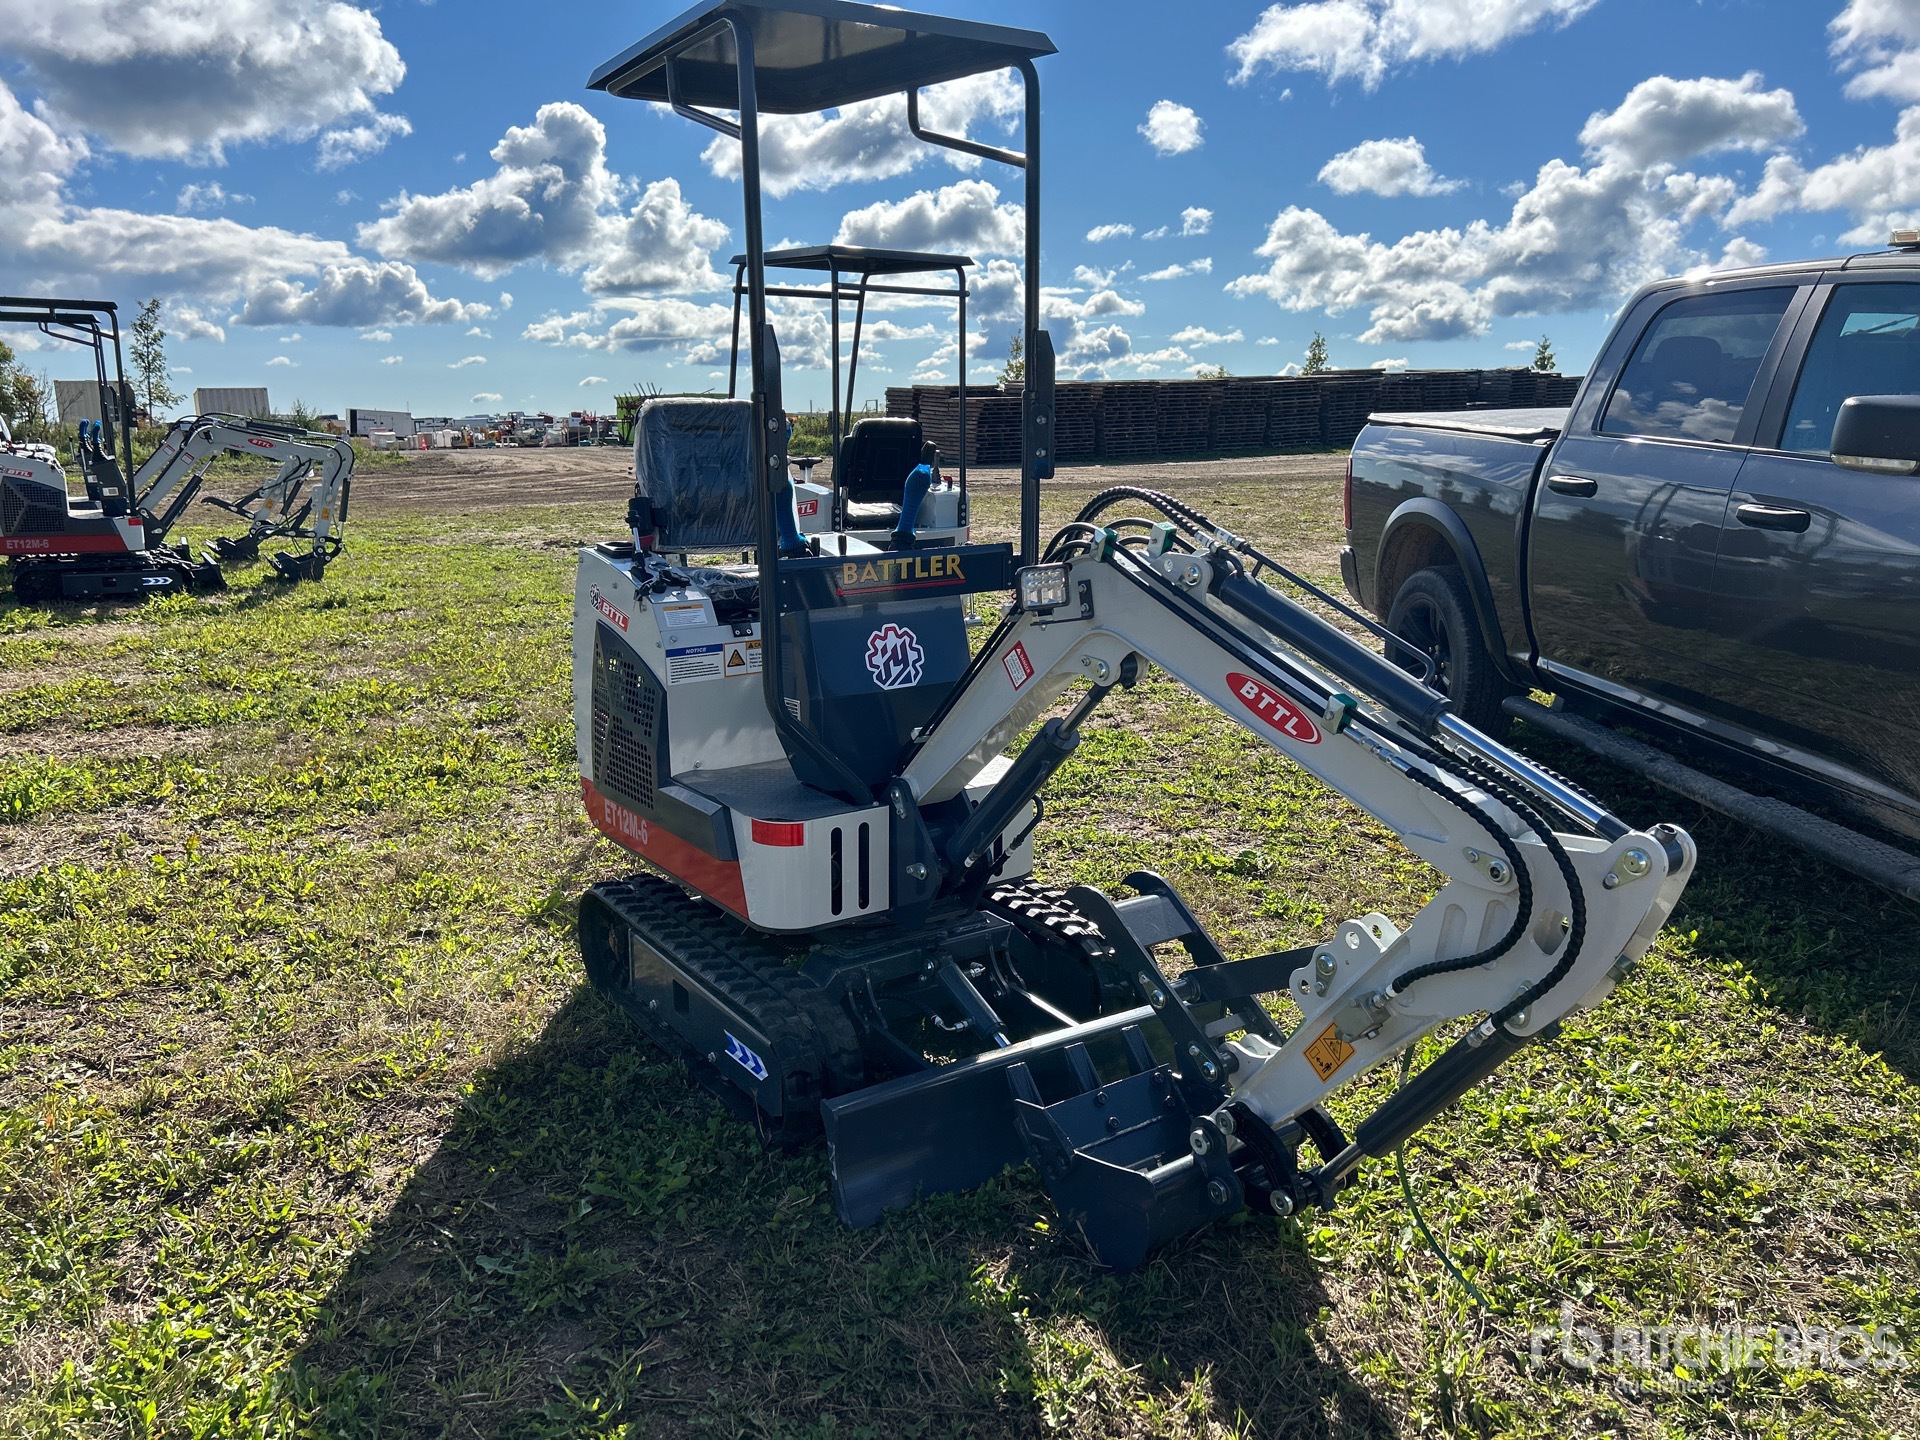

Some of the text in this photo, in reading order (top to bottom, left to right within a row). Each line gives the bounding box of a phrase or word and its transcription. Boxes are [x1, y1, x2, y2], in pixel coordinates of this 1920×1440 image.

[6, 539, 49, 549] ET12M-6
[843, 554, 965, 585] BATTLER
[602, 602, 625, 627] BTTL
[685, 647, 707, 655] NOTICE
[1240, 681, 1299, 736] BTTL
[605, 799, 648, 845] ET12M-6
